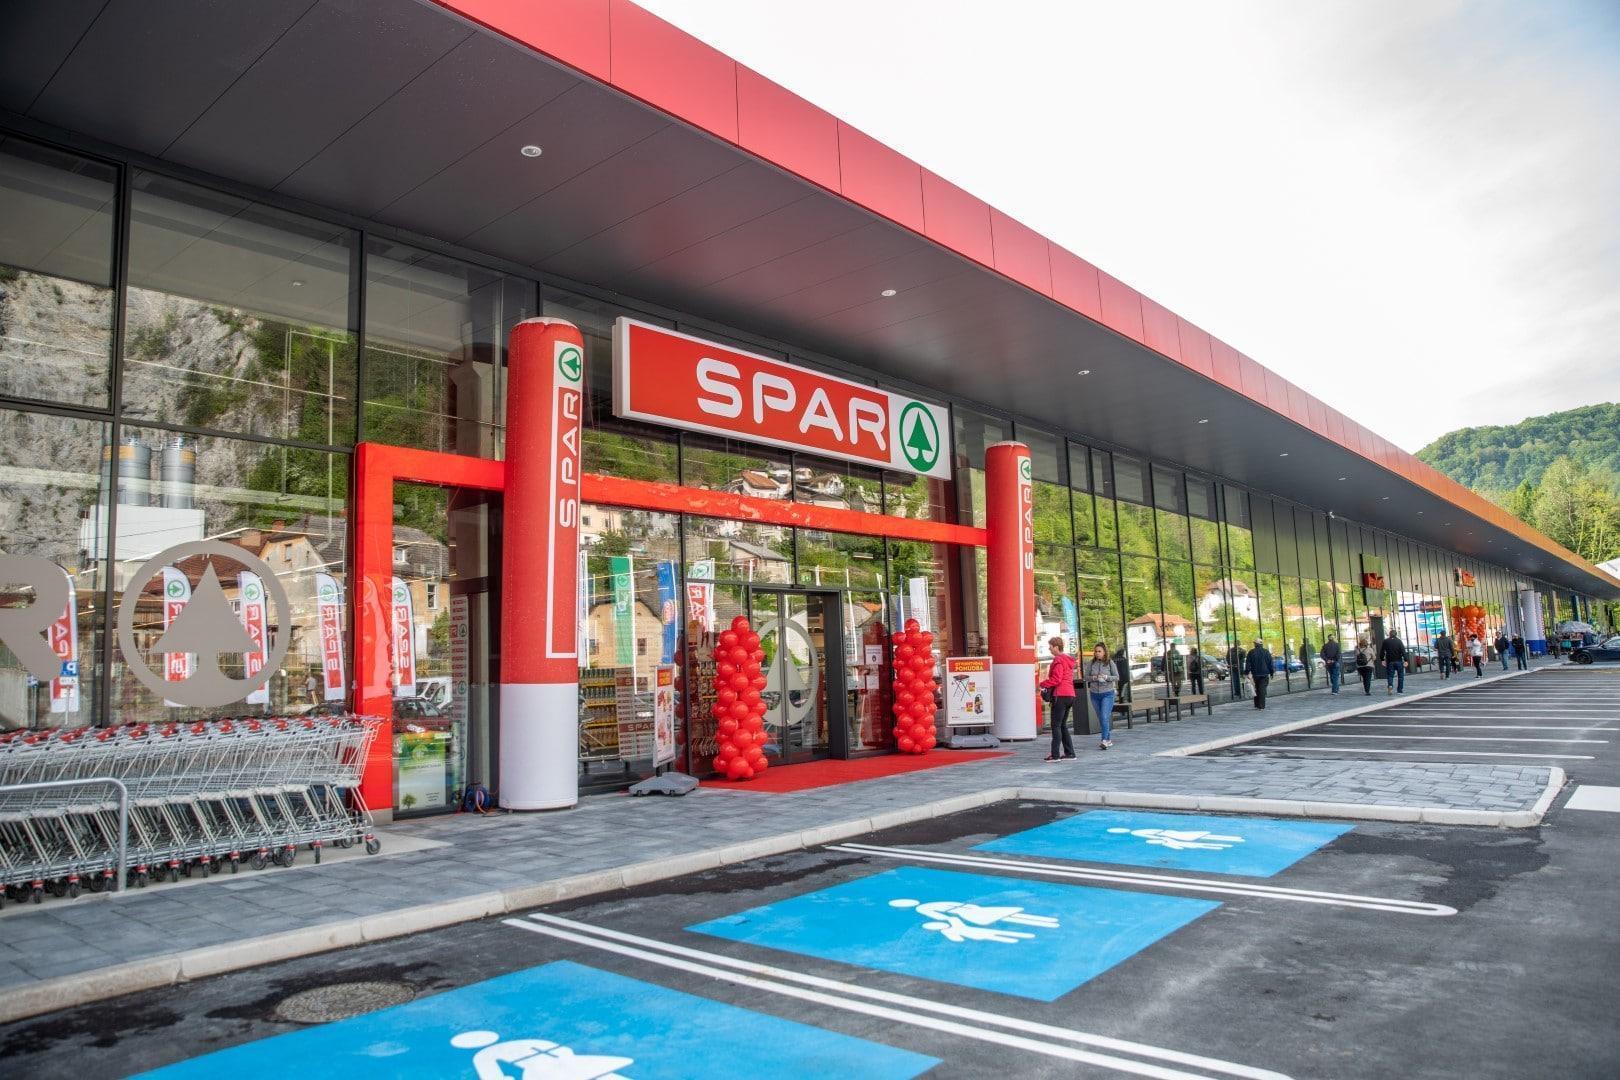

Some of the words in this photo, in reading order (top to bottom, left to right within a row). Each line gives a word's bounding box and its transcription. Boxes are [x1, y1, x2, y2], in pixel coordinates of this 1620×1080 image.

[696, 357, 887, 452] SPAR
[559, 391, 579, 529] SPAR
[1024, 487, 1033, 570] SPAR
